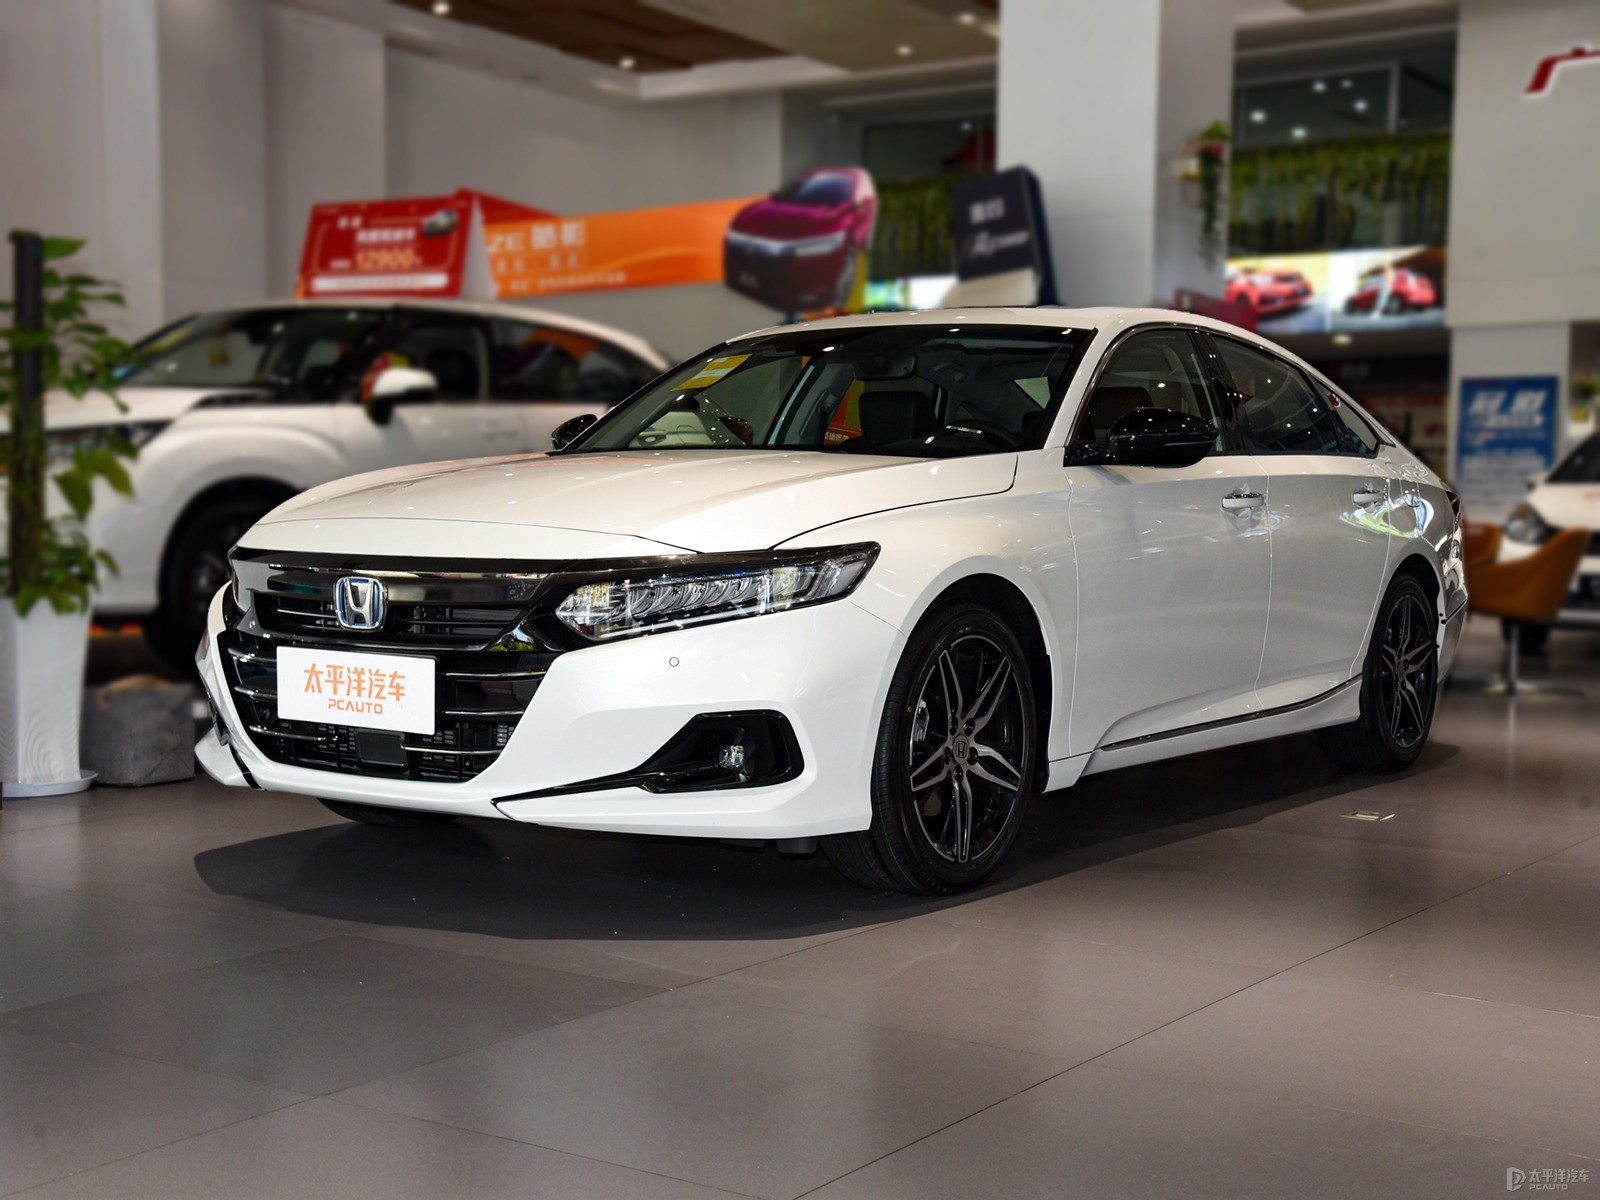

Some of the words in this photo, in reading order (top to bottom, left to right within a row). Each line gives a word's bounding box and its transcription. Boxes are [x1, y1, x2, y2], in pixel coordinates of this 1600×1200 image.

[304, 663, 406, 701] 太平洋汽车
[328, 698, 383, 715] PCAUTO
